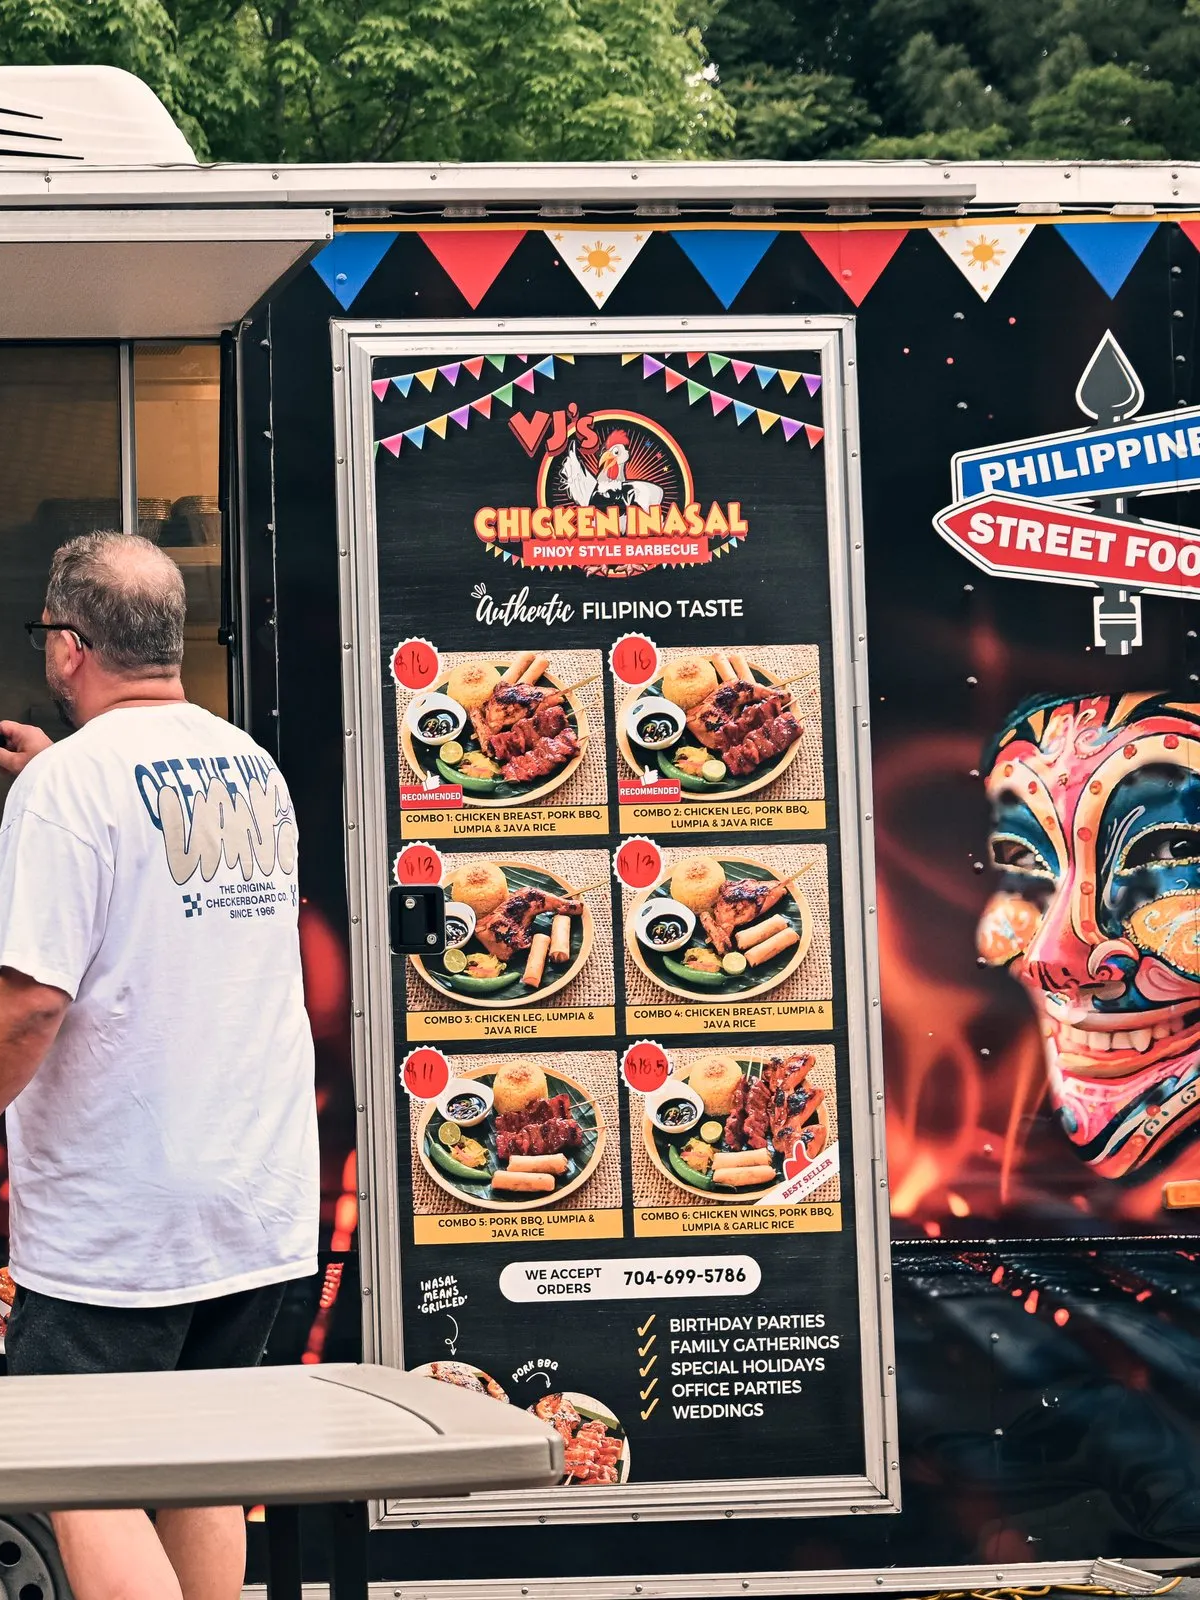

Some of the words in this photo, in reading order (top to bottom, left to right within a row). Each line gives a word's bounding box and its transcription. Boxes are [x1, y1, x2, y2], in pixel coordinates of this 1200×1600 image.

[473, 505, 622, 543] CHICKEN
[626, 500, 749, 540] INASAL
[967, 512, 1117, 564] STREET
[533, 545, 574, 558] PINOY
[578, 544, 622, 557] STYLE
[626, 543, 699, 557] BARBECUE
[475, 585, 575, 627] Authentic
[583, 600, 672, 620] FILIPINO
[677, 599, 744, 618] TASTE
[401, 791, 461, 801] RECOMMENDED
[619, 786, 679, 796] RECOMMENDED
[406, 814, 444, 823] COMBO
[446, 814, 453, 822] 1:
[455, 812, 500, 822] CHICKEN
[503, 811, 545, 821] BREAST,
[548, 811, 576, 819] PORK
[633, 808, 671, 818] COMBO
[674, 808, 682, 817] 2:
[684, 807, 728, 817] CHICKEN
[731, 806, 753, 816] LEG,
[756, 805, 784, 815] PORK
[454, 825, 492, 834] LUMPIA
[494, 824, 501, 833] &
[503, 824, 530, 833] JAVA
[533, 823, 556, 832] RICE
[671, 819, 709, 829] LUMPIA
[712, 819, 719, 828] &
[721, 818, 748, 828] JAVA
[750, 817, 773, 827] RICE
[219, 885, 235, 895] THE
[236, 881, 276, 893] ORIGINAL
[206, 893, 276, 908] CHECKERBOARD
[230, 909, 252, 919] SINCE
[255, 906, 275, 917] 1966
[424, 1015, 462, 1025] COMBO
[464, 1015, 472, 1024] 3:
[474, 1014, 520, 1023] CHICKEN
[523, 1013, 545, 1023] LEG,
[547, 1012, 585, 1022] LUMPIA
[588, 1012, 595, 1021] &
[634, 1009, 672, 1019] COMBO
[674, 1009, 683, 1018] 4:
[685, 1008, 730, 1018] CHICKEN
[733, 1007, 775, 1017] BREAST,
[777, 1006, 815, 1015] LUMPIA
[818, 1005, 825, 1014] &
[484, 1026, 512, 1036] JAVA
[514, 1025, 537, 1034] RICE
[703, 1020, 730, 1029] JAVA
[733, 1019, 756, 1028] RICE
[781, 1181, 802, 1200] BEST
[803, 1158, 833, 1185] SELLER
[438, 1218, 476, 1228] COMBO
[479, 1218, 487, 1227] 5:
[489, 1217, 518, 1226] PORK
[520, 1216, 545, 1226] BBQ,
[547, 1214, 585, 1224] LUMPIA
[588, 1214, 595, 1223] &
[641, 1211, 680, 1221] COMBO
[682, 1211, 690, 1220] 6:
[692, 1210, 737, 1220] CHICKEN
[740, 1209, 778, 1219] WINGS,
[779, 1208, 807, 1217] PORK
[491, 1229, 519, 1238] JAVA
[521, 1228, 544, 1237] RICE
[682, 1222, 721, 1232] LUMPIA
[723, 1222, 730, 1231] &
[732, 1221, 769, 1231] GARLIC
[771, 1220, 794, 1230] RICE
[525, 1269, 547, 1281] WE
[550, 1267, 602, 1280] ACCEPT
[624, 1268, 746, 1286] 704-699-5786
[420, 1275, 458, 1292] INASAL
[536, 1282, 591, 1295] ORDERS
[423, 1285, 460, 1303] MEANS
[669, 1316, 753, 1333] BIRTHDAY
[757, 1314, 825, 1330] PARTIES
[670, 1338, 730, 1354] FAMILY
[733, 1335, 840, 1352] GATHERINGS
[511, 1360, 535, 1383] PORK
[537, 1358, 559, 1372] BBQ
[671, 1360, 738, 1376] SPECIAL
[743, 1357, 825, 1374] HOLIDAYS
[672, 1383, 730, 1398] OFFICE
[734, 1380, 802, 1396] PARTIES
[672, 1403, 764, 1420] WEDDINGS
